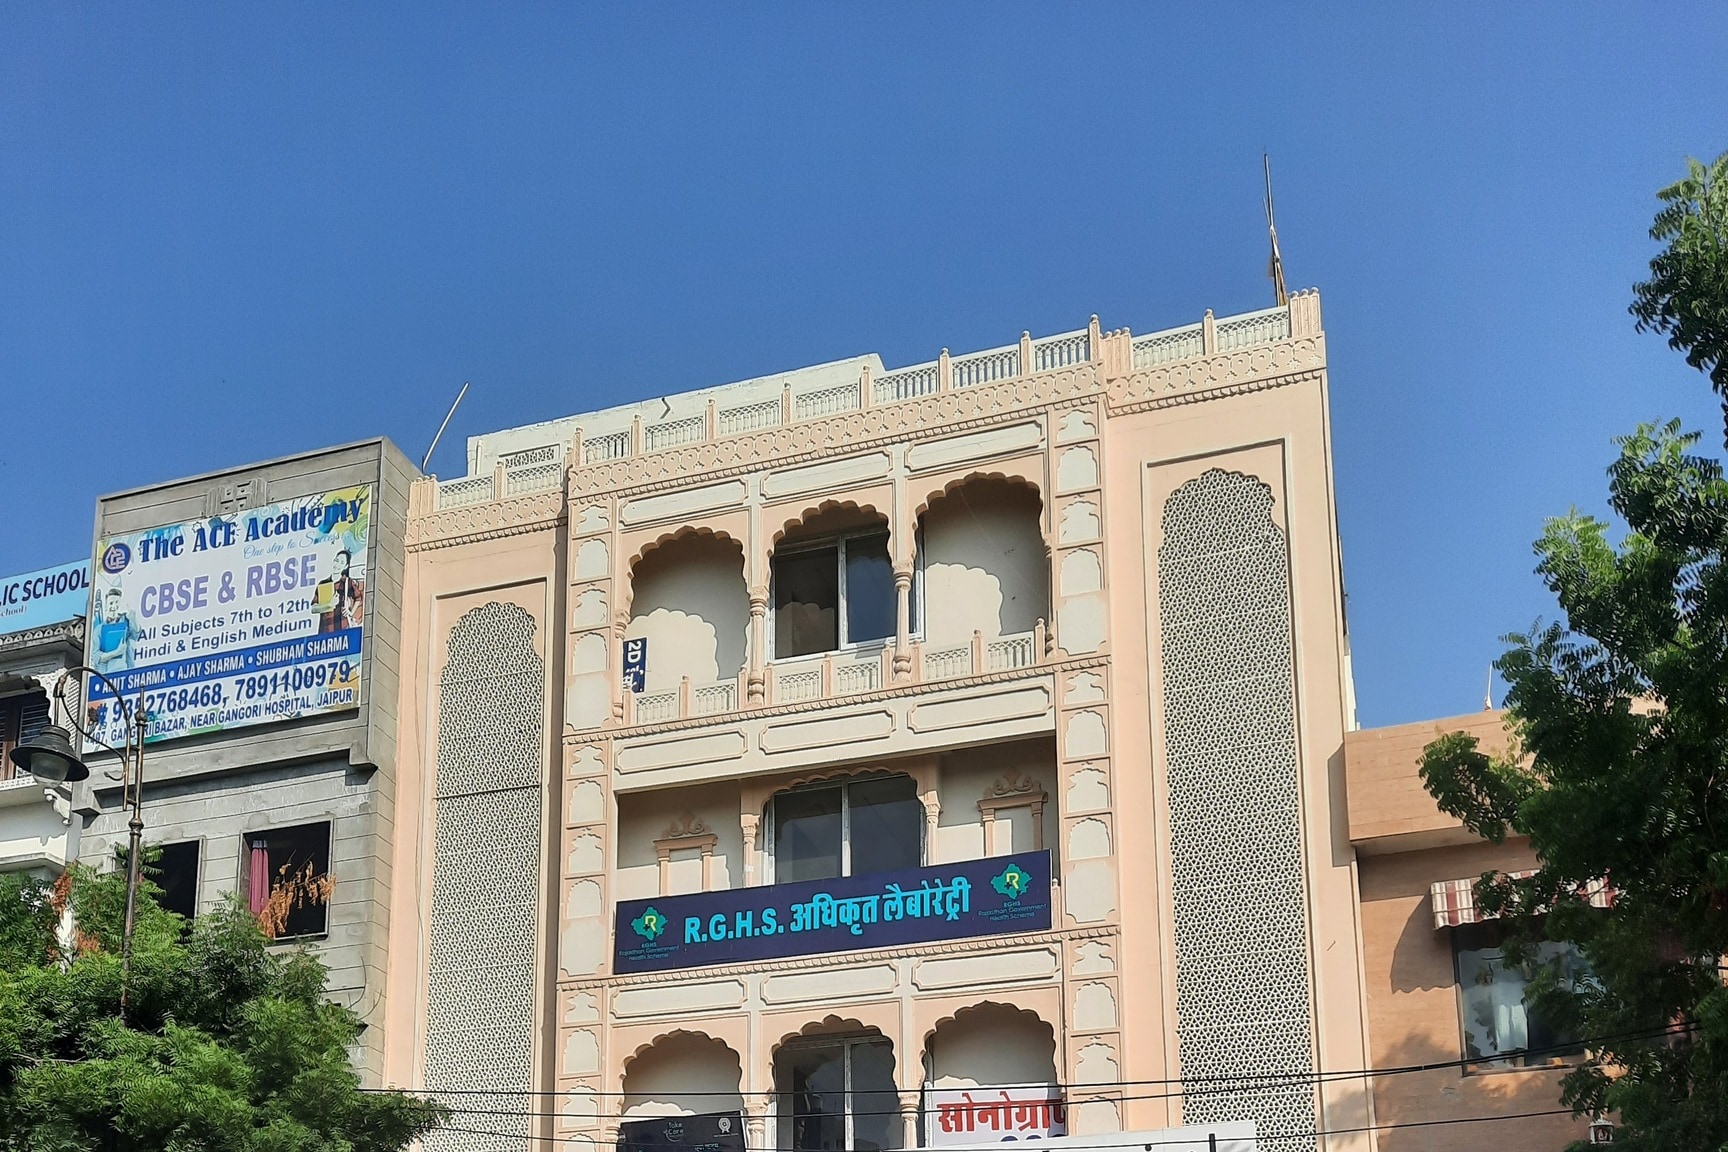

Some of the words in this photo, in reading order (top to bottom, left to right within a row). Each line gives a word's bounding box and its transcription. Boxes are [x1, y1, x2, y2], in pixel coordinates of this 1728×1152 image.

[139, 534, 184, 563] The
[192, 521, 237, 552] ACE
[244, 498, 365, 542] Academy
[0, 585, 19, 606] IC
[22, 567, 90, 602] SCHOOL
[141, 575, 209, 618] CBSE
[218, 571, 236, 603] &
[246, 554, 317, 599] RBSE
[134, 642, 171, 660] Hindi
[176, 640, 186, 652] &
[191, 629, 246, 649] English
[253, 618, 312, 638] Medium
[137, 627, 156, 641] All
[161, 617, 225, 637] Subjects
[231, 610, 252, 624] 7th
[258, 607, 272, 619] to
[278, 598, 310, 615] 12th
[128, 669, 166, 689] SHARMA
[177, 662, 202, 680] AJAY
[204, 654, 245, 676] SHARMA
[256, 643, 305, 666] SHUBHAM
[307, 635, 349, 656] SHARMA
[235, 660, 351, 701] 7891100979
[111, 724, 152, 743] GANGRI
[154, 717, 188, 735] BAZAR,
[190, 712, 216, 728] NEAR
[218, 705, 262, 723] GANGORI
[265, 695, 314, 716] HOSPITAL,
[317, 688, 353, 706] JAIPUR
[684, 908, 785, 944] R.G.H.S.
[790, 893, 879, 935] अधिकृत
[883, 876, 971, 921] लैबोरेट्री
